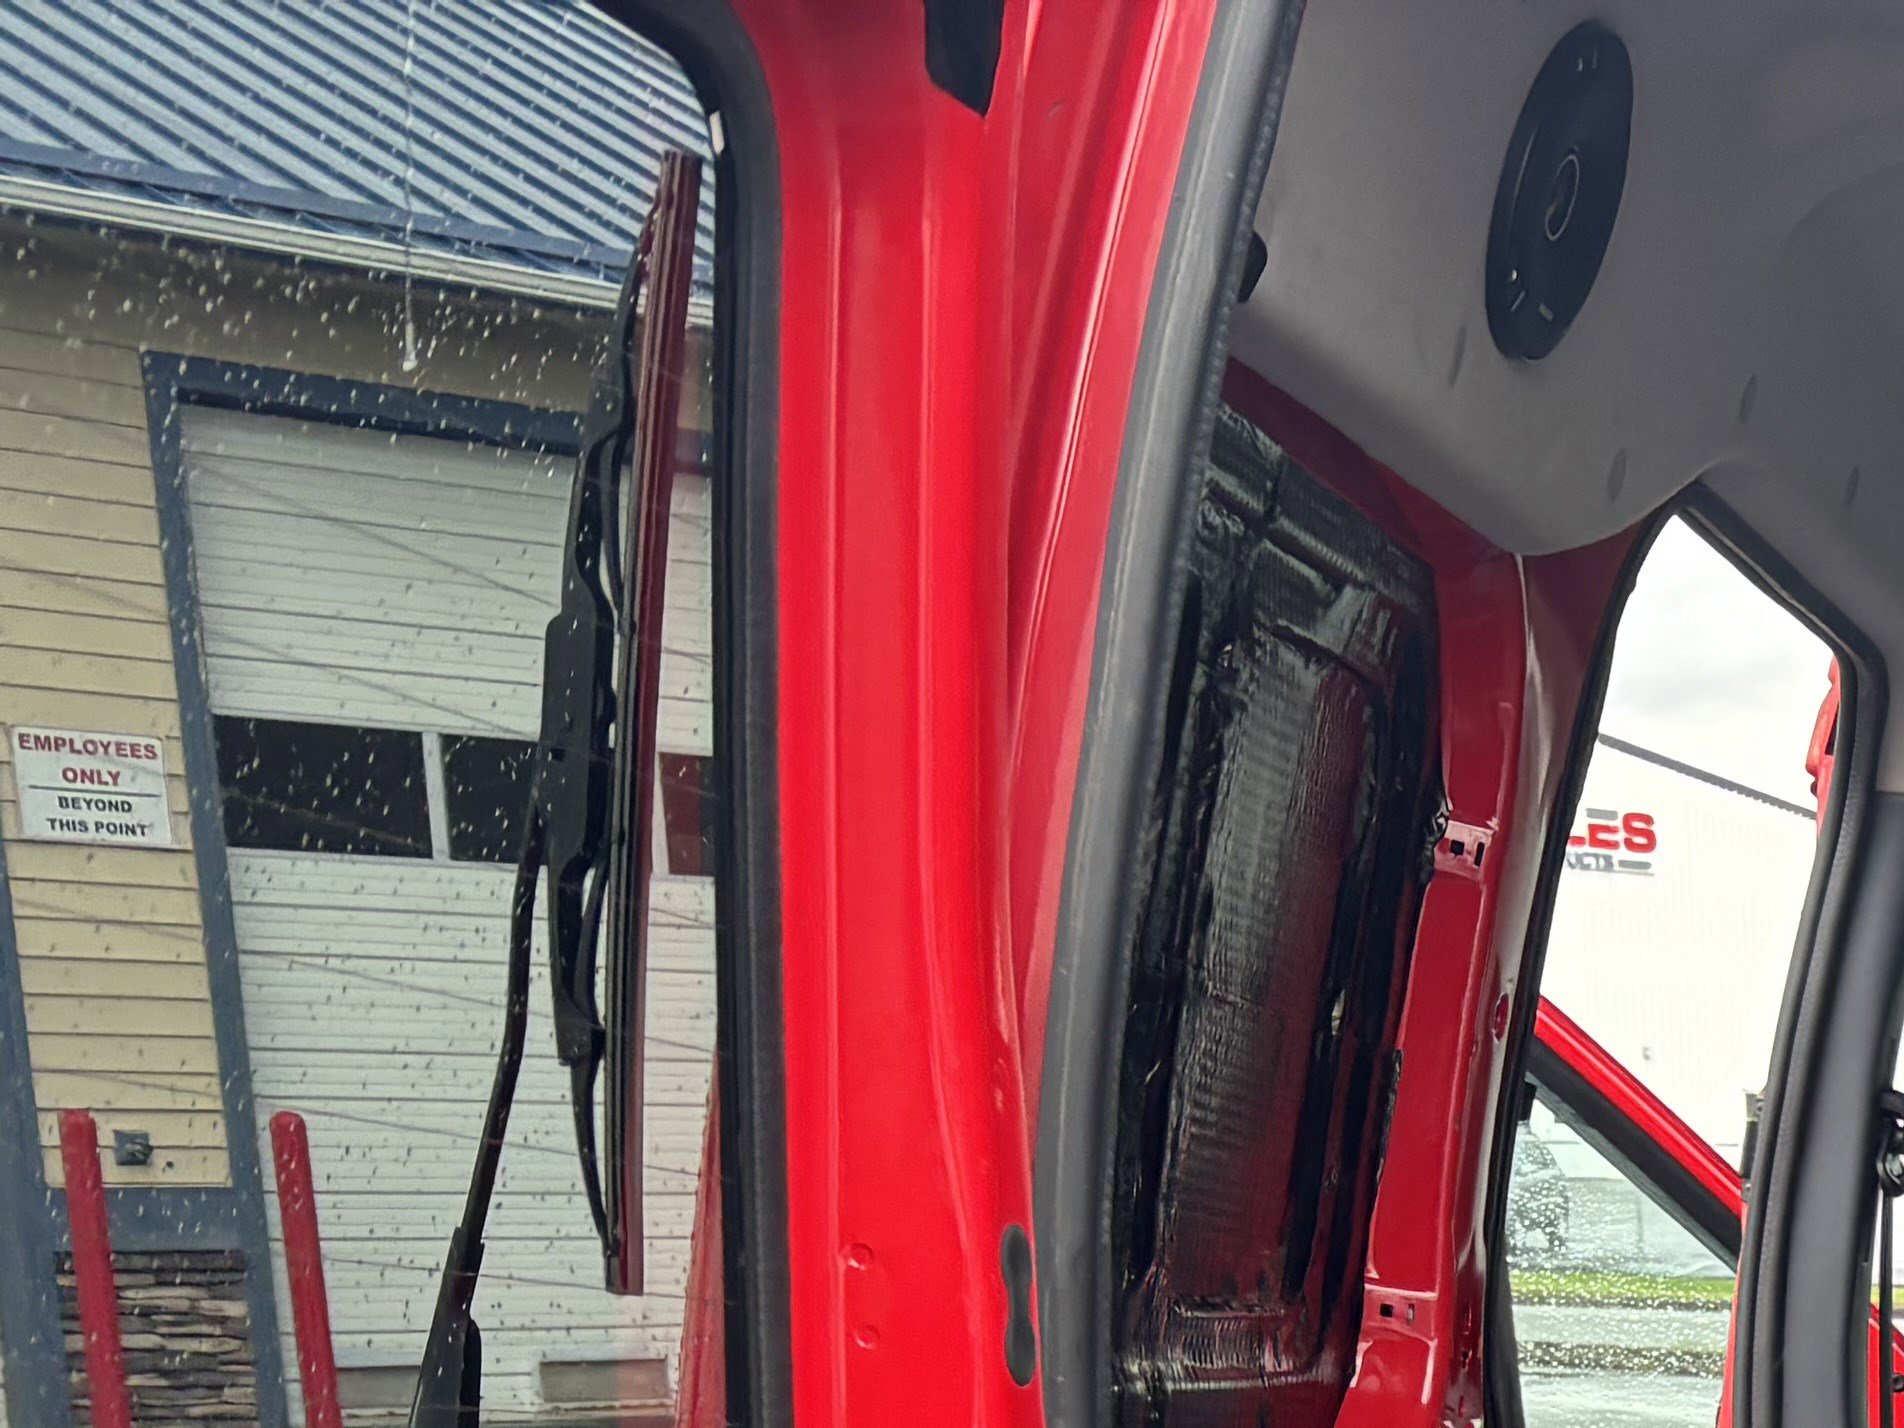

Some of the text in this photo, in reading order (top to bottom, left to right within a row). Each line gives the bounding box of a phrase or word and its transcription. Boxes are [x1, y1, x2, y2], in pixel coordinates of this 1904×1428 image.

[18, 733, 158, 760] EMPLOYEES
[62, 767, 121, 786] ONLY
[57, 796, 133, 813] BEYOND
[46, 818, 149, 837] THIS POINT
